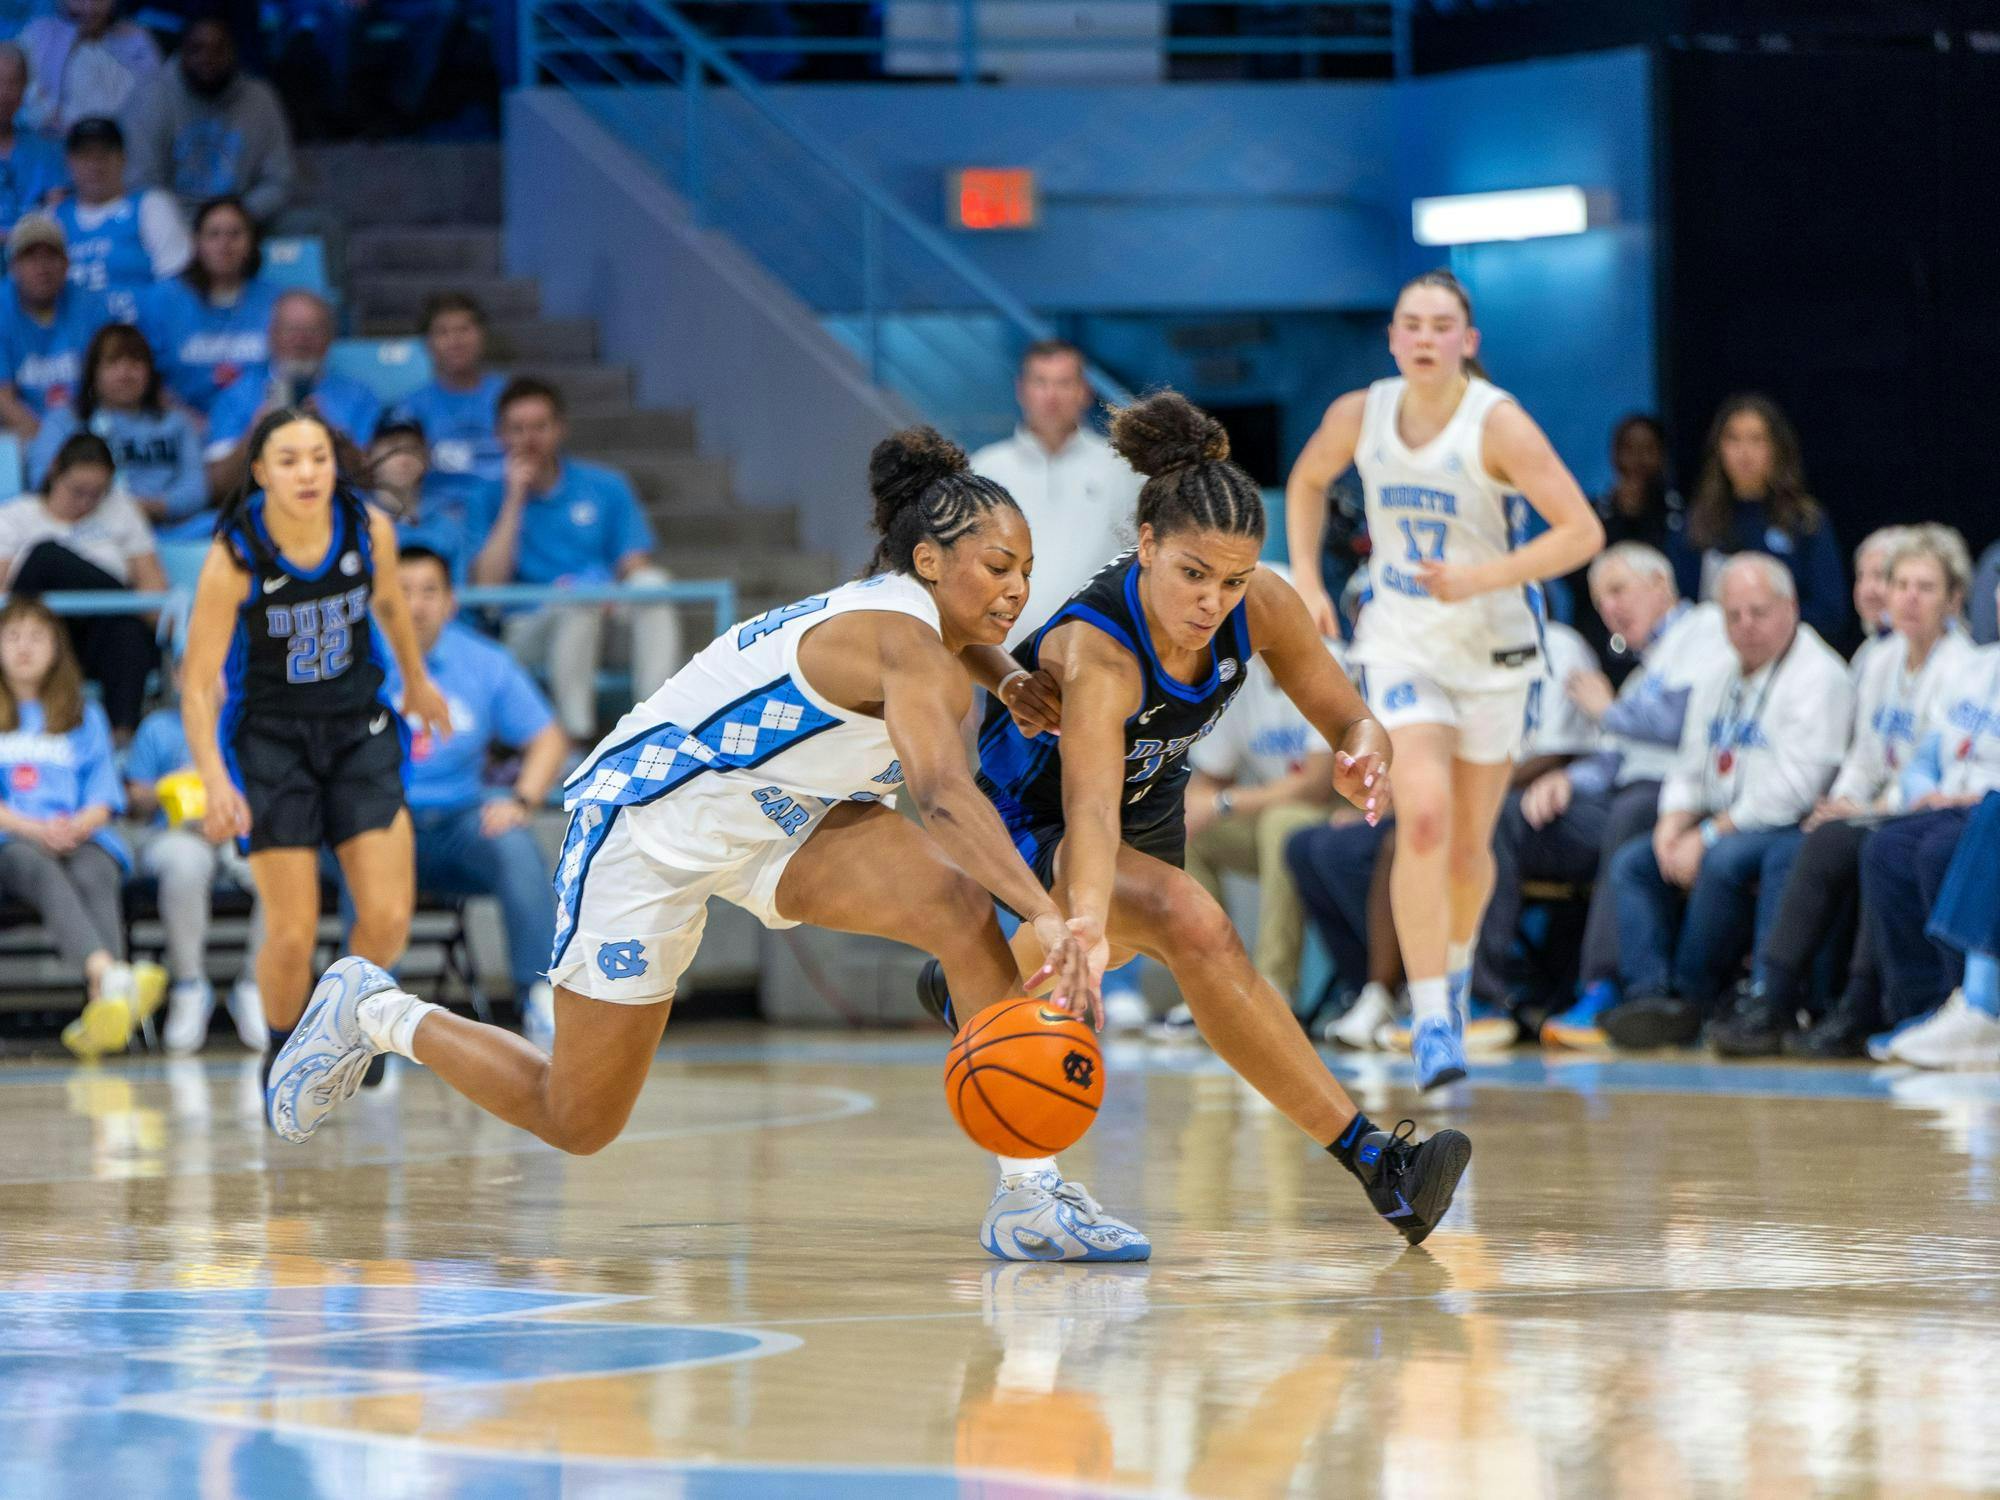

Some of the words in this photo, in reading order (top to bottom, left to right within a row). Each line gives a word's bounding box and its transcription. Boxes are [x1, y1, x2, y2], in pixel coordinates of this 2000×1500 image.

[1397, 518, 1447, 562] 17
[266, 583, 369, 638] DUKE
[286, 625, 354, 684] 22
